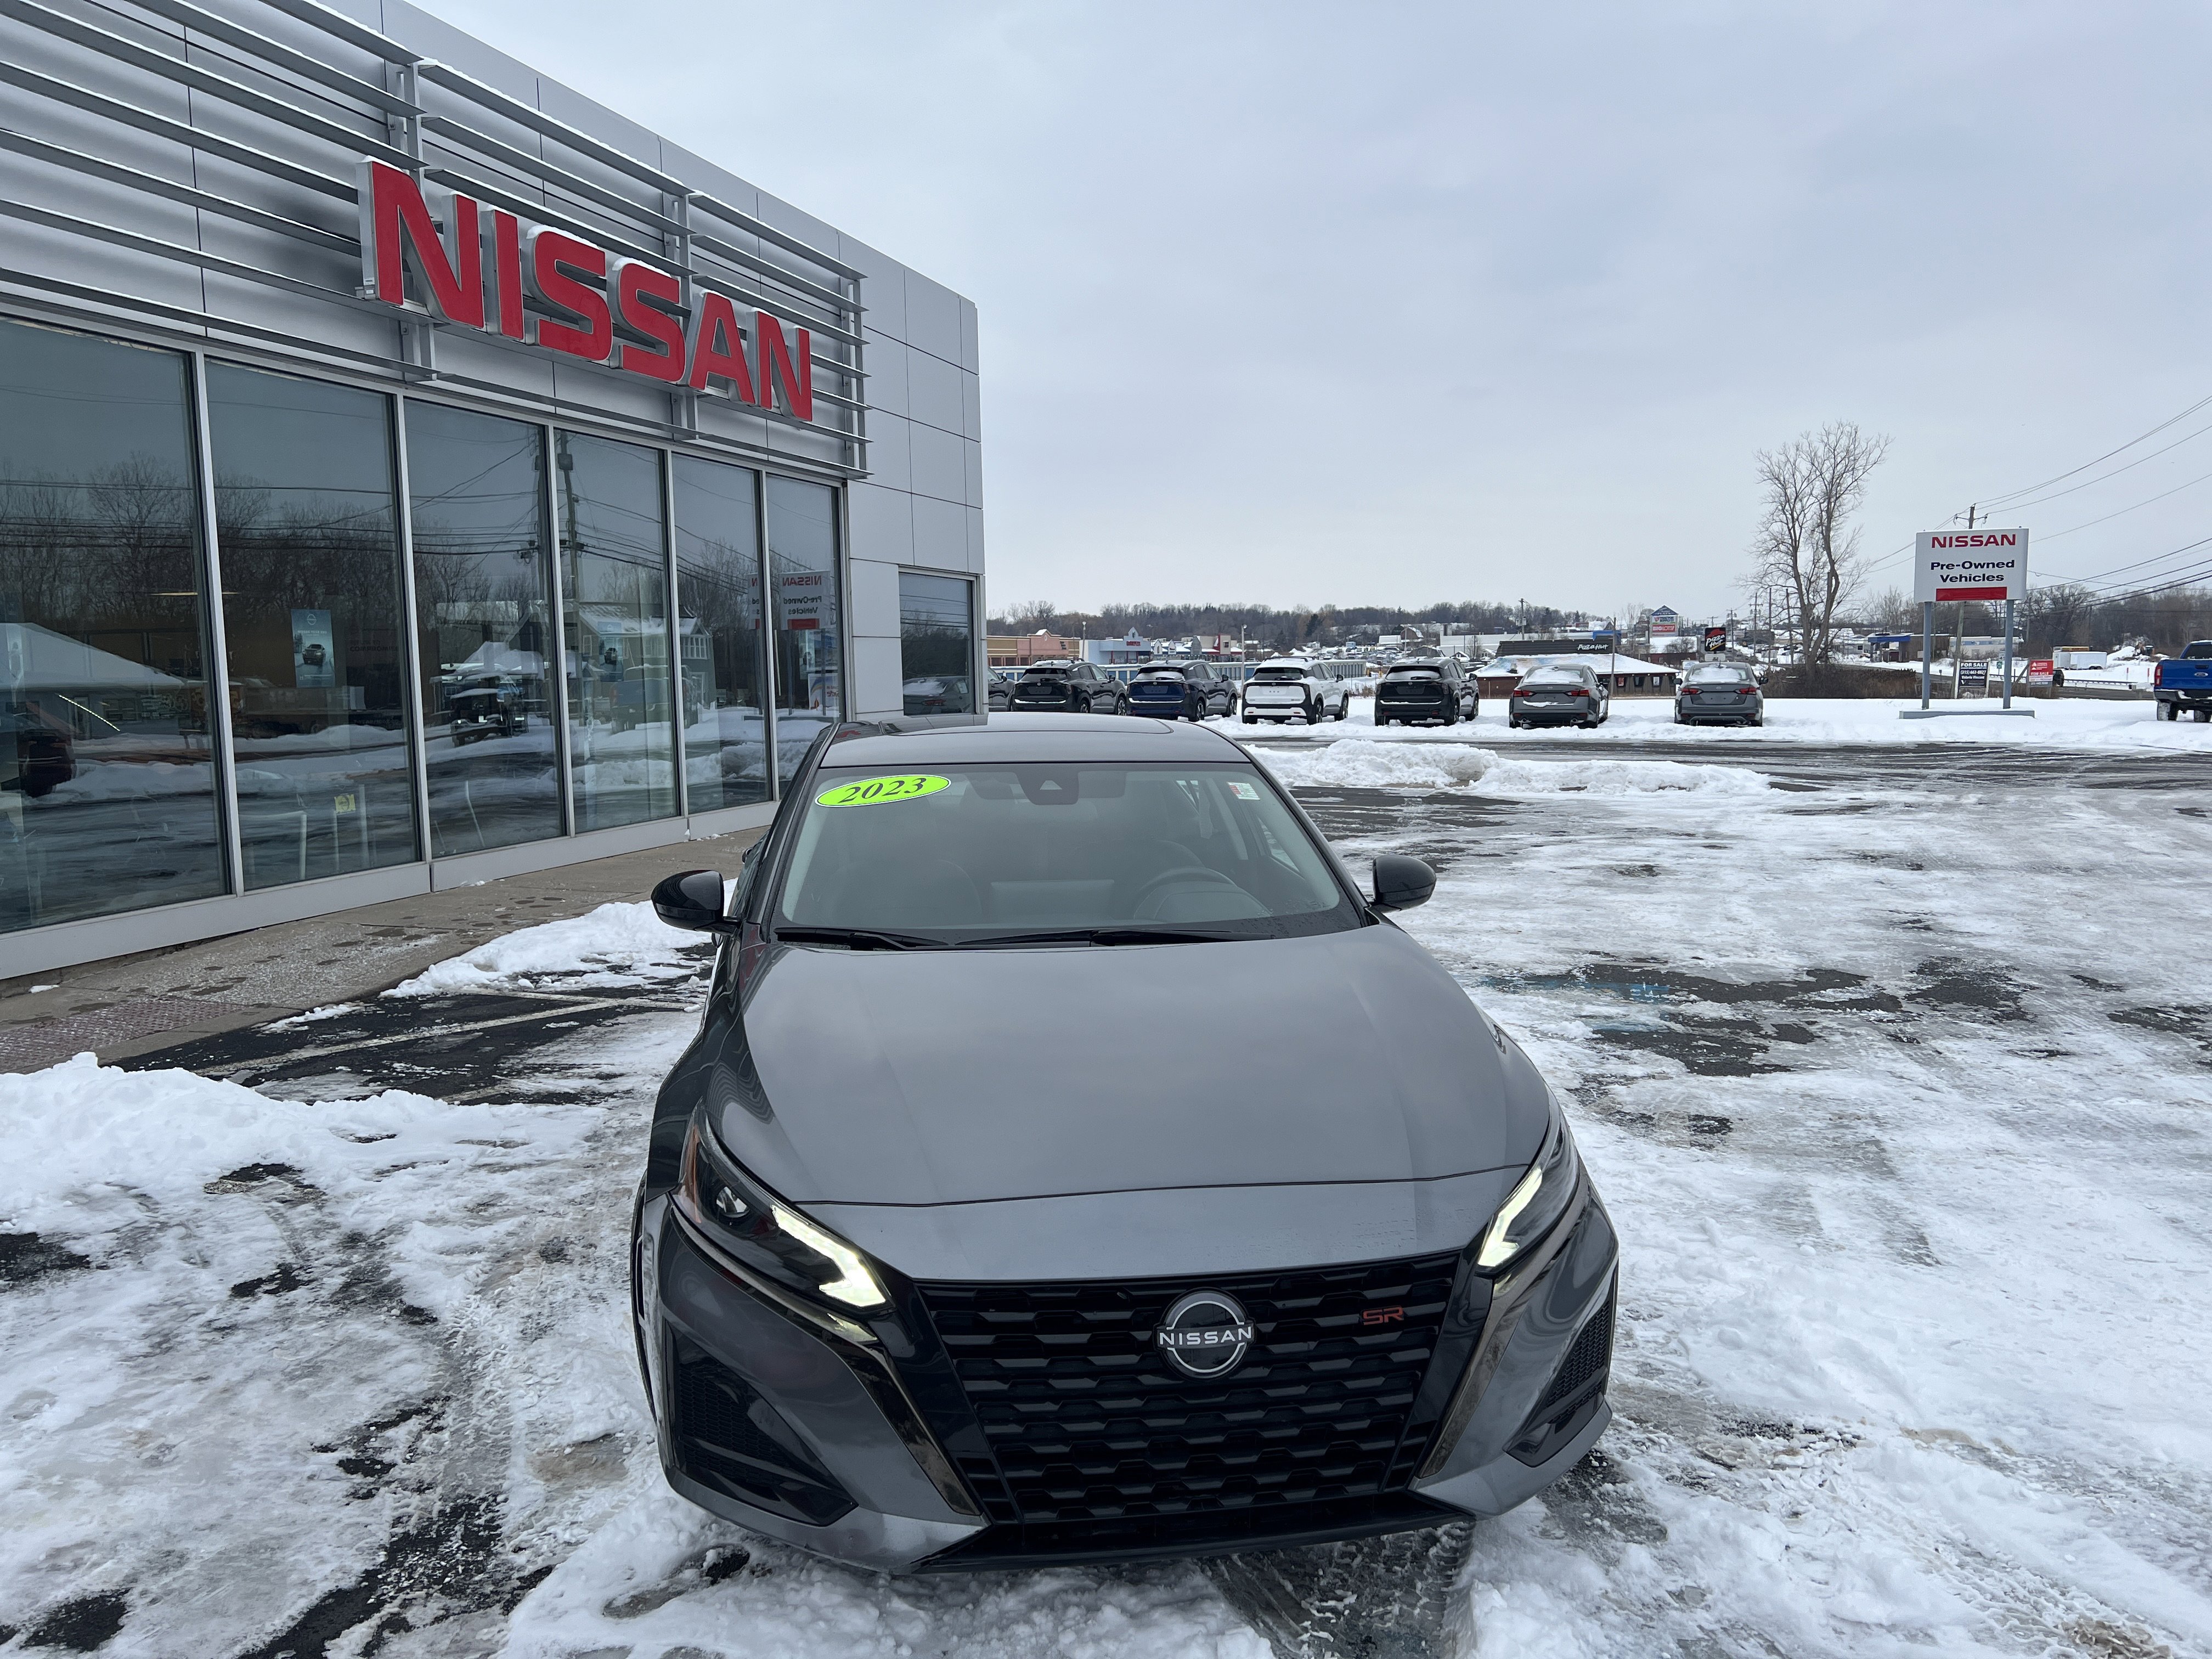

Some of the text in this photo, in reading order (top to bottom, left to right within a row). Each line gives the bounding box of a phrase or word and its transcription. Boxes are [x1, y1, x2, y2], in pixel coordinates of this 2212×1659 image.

[371, 160, 813, 422] NISSAN
[1931, 534, 2016, 548] NISSAN
[1931, 560, 2015, 570] Pre-Owned
[1940, 573, 2004, 583] Vehicles
[1706, 634, 1725, 647] Pizza
[1709, 639, 1724, 648] Hut
[838, 777, 927, 804] 2023
[1363, 1306, 1404, 1325] SR
[1159, 1325, 1252, 1346] NISSAN
